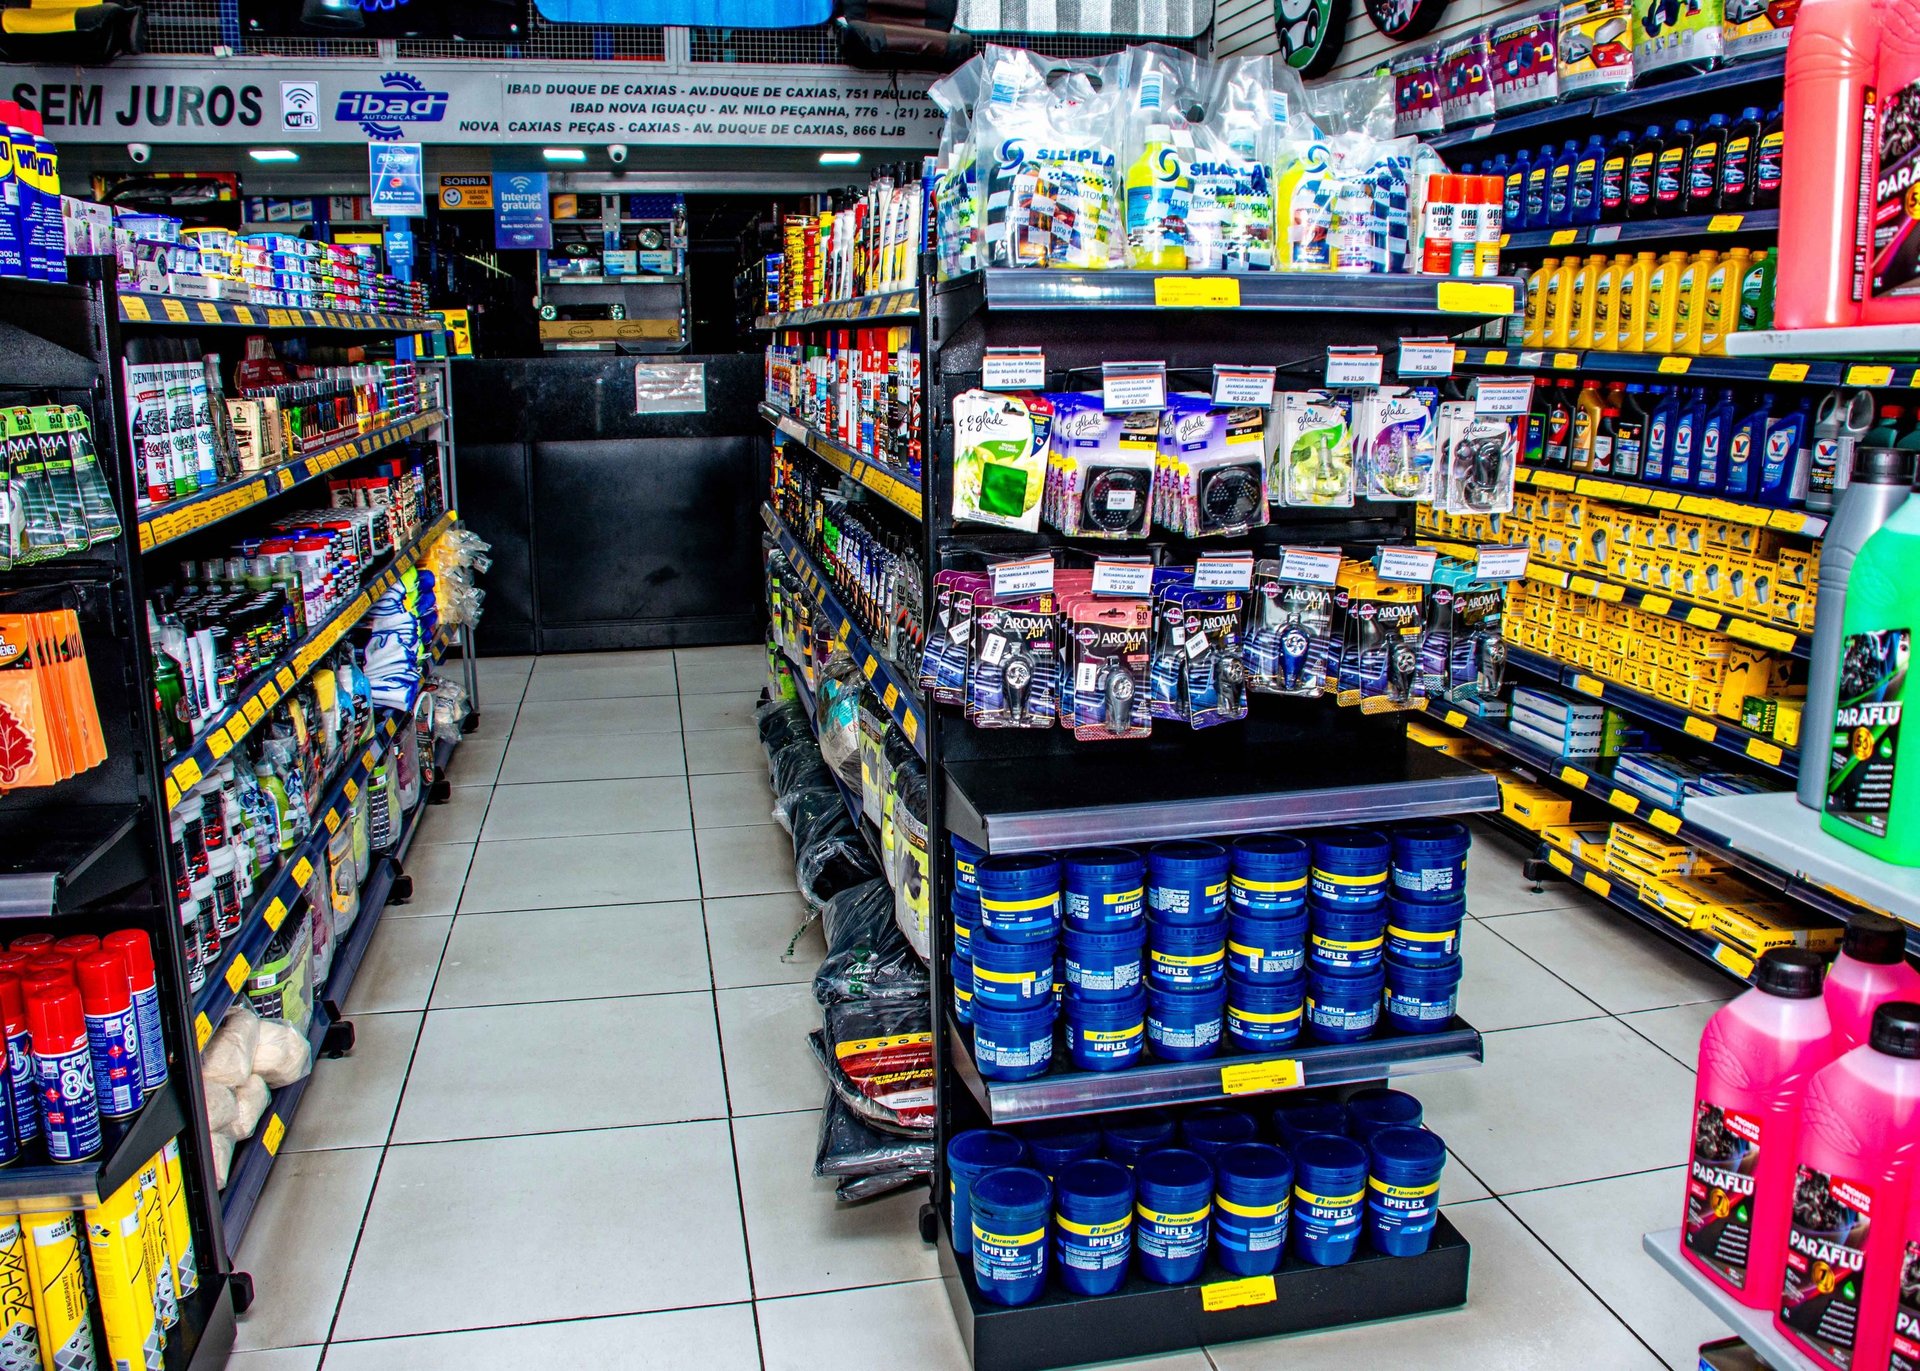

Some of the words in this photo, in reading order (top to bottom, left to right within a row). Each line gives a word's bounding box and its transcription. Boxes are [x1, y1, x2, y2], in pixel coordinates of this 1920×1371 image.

[1500, 24, 1538, 41] MASTER
[507, 84, 541, 95] IBAD
[546, 84, 597, 96] DUQUE
[601, 85, 620, 95] DE
[624, 85, 677, 96] CAXIAS
[690, 86, 759, 97] AV.DUQUE
[763, 87, 781, 97] DE
[786, 87, 841, 100] CAXIAS,
[846, 88, 869, 98] 751
[12, 83, 103, 126] SEM
[115, 85, 262, 126] JUROS
[351, 94, 435, 114] ibad
[570, 103, 604, 113] IBAD
[608, 103, 646, 113] NOVA
[651, 104, 706, 117] IGUAÇU
[719, 104, 738, 115] AV.
[743, 105, 776, 115] NILO
[781, 105, 849, 118] PEÇANHA,
[855, 107, 878, 117] 776
[894, 107, 919, 120] (21)
[459, 121, 499, 132] NOVA
[508, 122, 562, 132] CAXIAS
[569, 122, 615, 134] PEÇAS
[628, 123, 680, 133] CAXIAS
[693, 123, 712, 133] AV.
[718, 124, 766, 134] DUQUE
[771, 124, 789, 134] DE
[794, 124, 848, 137] CAXIAS,
[853, 126, 876, 136] 866
[880, 126, 906, 136] LJB
[444, 177, 487, 186] SORRIA
[379, 191, 394, 200] 5X
[501, 192, 541, 201] Internet
[502, 201, 542, 212] gratuita
[1002, 360, 1016, 368] Toque
[1026, 368, 1042, 376] Campo
[16, 415, 31, 425] 60
[49, 414, 62, 424] 60
[1381, 405, 1410, 423] glade
[976, 411, 1008, 432] glade
[1075, 414, 1101, 435] glade
[1297, 412, 1327, 431] glade
[1180, 416, 1205, 441] glade
[1589, 512, 1611, 523] Tecfil
[1704, 552, 1723, 560] Tecfil
[1729, 557, 1747, 566] Tecfil
[1780, 553, 1807, 564] Tecfil
[1753, 563, 1772, 572] Tecfil
[1284, 589, 1331, 603] AROMA
[1407, 587, 1417, 595] 60
[1775, 590, 1800, 601] Tecfil
[1041, 599, 1052, 607] 60
[1468, 593, 1500, 608] AROMA
[1137, 612, 1148, 620] 60
[1378, 605, 1419, 618] AROMA
[1003, 617, 1053, 630] AROMA
[1203, 613, 1238, 629] AROMA
[1026, 627, 1045, 639] Air
[1101, 632, 1148, 644] AROMA
[1123, 641, 1141, 653] Air
[1572, 712, 1603, 721] Tecfil
[1837, 707, 1900, 726] PARAFLU
[1616, 827, 1635, 840] Tecfil
[1115, 901, 1141, 914] IPIFLEX
[1712, 913, 1733, 928] Tecfil
[1271, 949, 1295, 957] IPIFLEX
[1318, 948, 1348, 960] IPIFLEX
[1158, 964, 1189, 976] IPIFLEX
[1398, 995, 1420, 1004] IPIFLEX
[1321, 1005, 1345, 1014] IPIFLEX
[1094, 1042, 1127, 1052] IPIFLEX
[1692, 1161, 1754, 1196] PARAFLU
[1842, 1182, 1871, 1204] PRONTO
[1384, 1197, 1425, 1209] IPIFLEX
[1312, 1207, 1354, 1219] IPIFLEX
[51, 1224, 65, 1235] LEVE
[52, 1229, 67, 1239] MAIS
[1155, 1225, 1194, 1236] IPIFLEX
[1089, 1232, 1125, 1247] IPIFLEX
[981, 1243, 1019, 1257] IPIFLEX
[1790, 1230, 1864, 1271] PARAFLU
